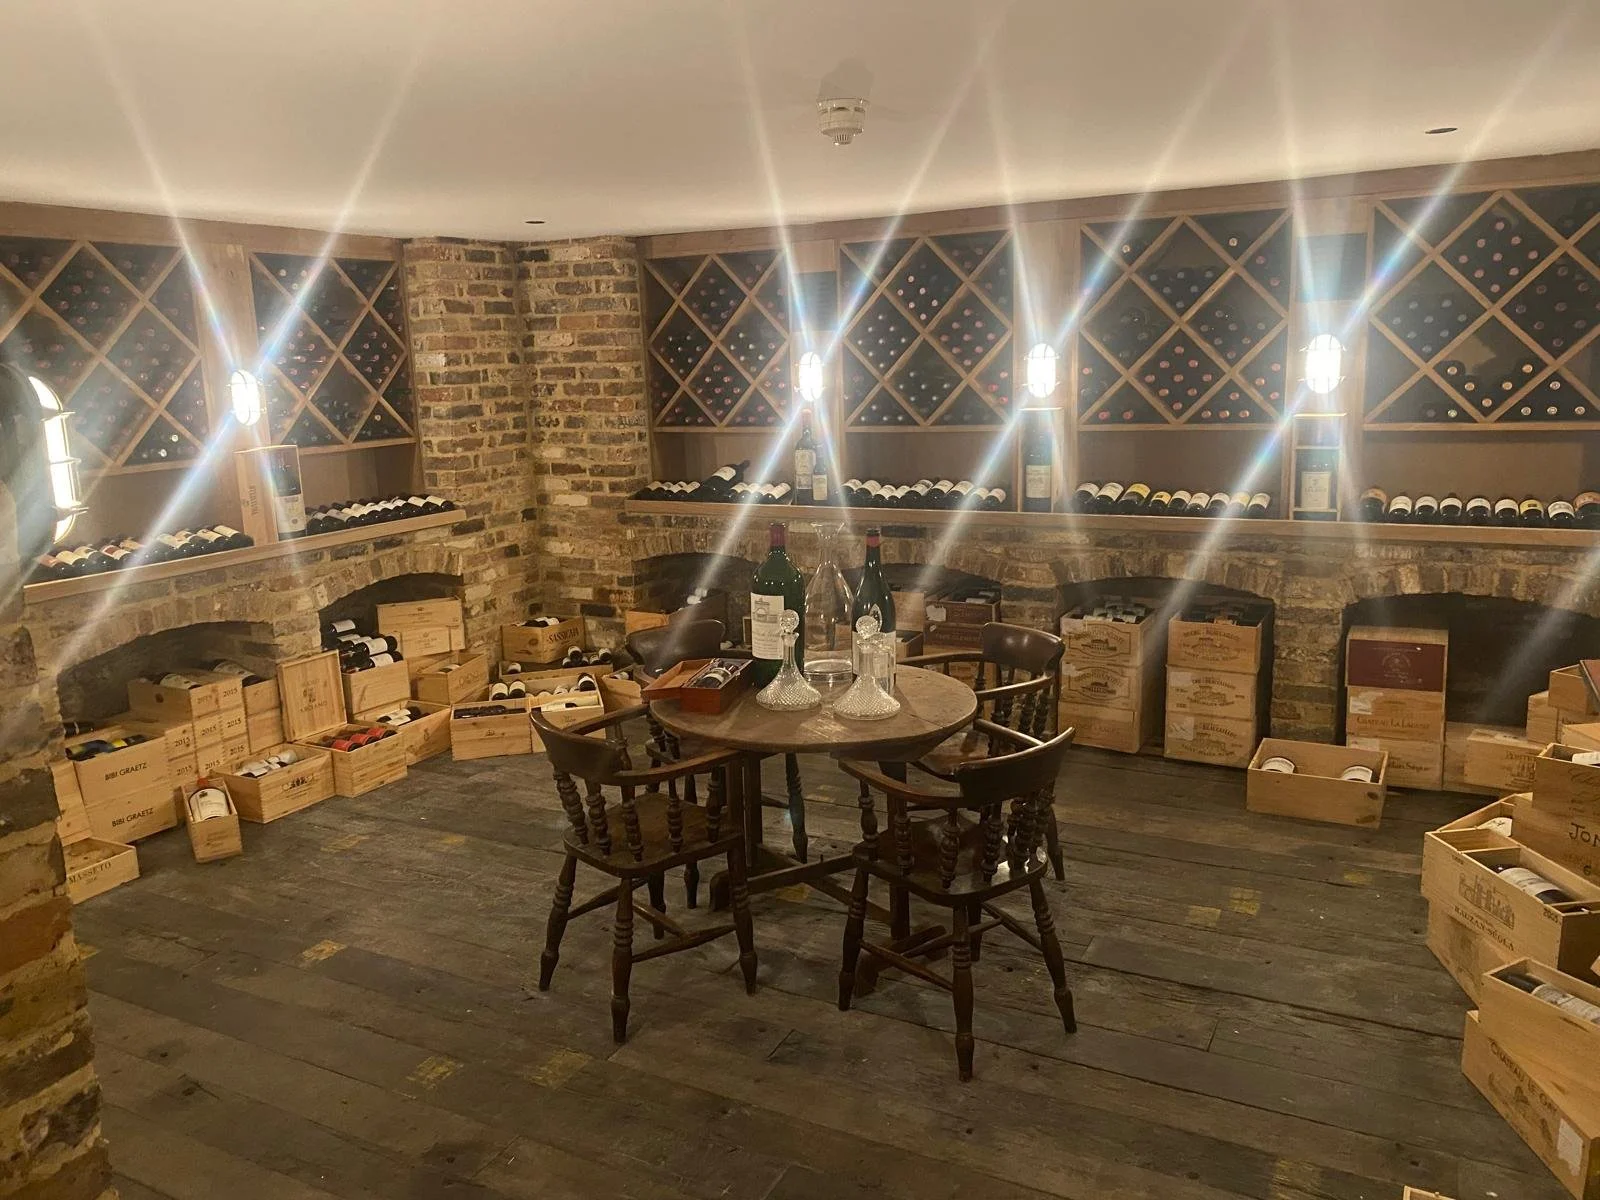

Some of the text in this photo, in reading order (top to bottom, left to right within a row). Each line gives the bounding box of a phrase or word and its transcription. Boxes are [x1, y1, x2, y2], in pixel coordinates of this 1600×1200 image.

[223, 687, 238, 697] 2015
[227, 717, 242, 728] 2015
[201, 724, 217, 736] 2015
[230, 744, 245, 755] 2015
[205, 760, 220, 770] 2015
[105, 762, 148, 781] BIBI GRAETZ
[112, 807, 154, 828] BIBI GRAETZ
